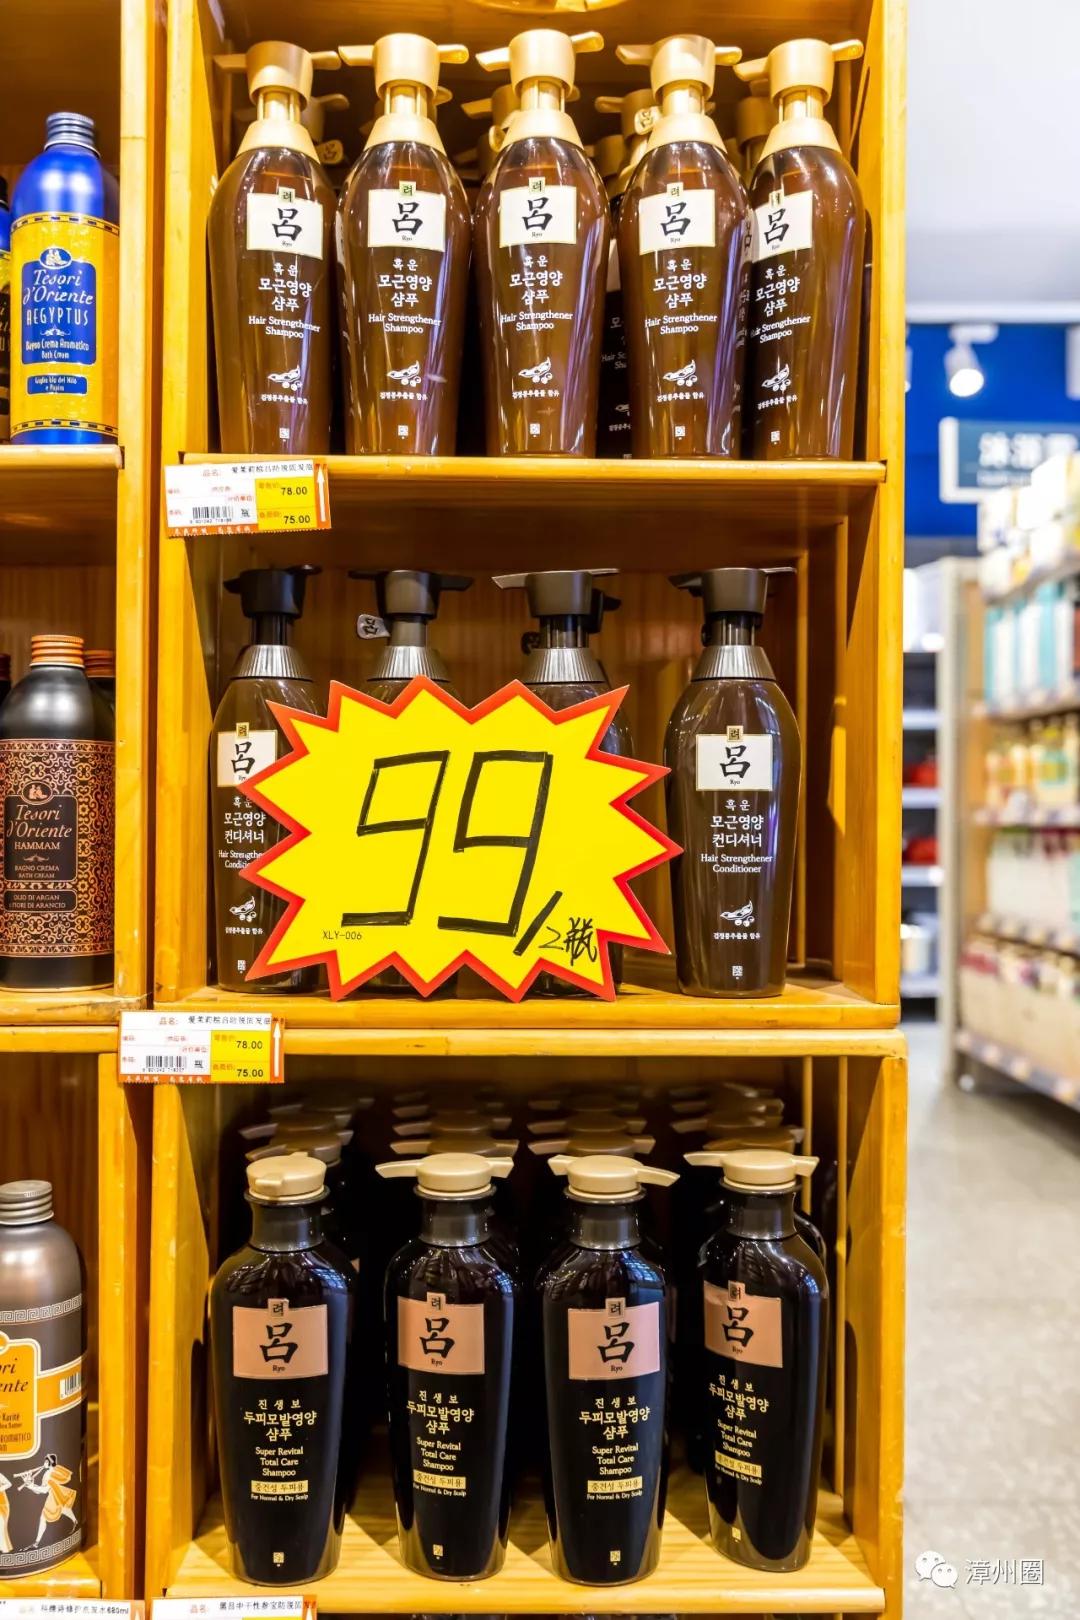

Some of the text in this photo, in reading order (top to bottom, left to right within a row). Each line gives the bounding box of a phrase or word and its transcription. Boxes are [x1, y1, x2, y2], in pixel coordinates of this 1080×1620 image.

[392, 202, 423, 235] 呂
[522, 197, 553, 231] 呂
[660, 201, 691, 236] 呂
[272, 208, 302, 241] 呂
[764, 208, 790, 245] 呂
[33, 269, 82, 286] Tesori
[378, 274, 432, 291] 모근영양
[509, 270, 563, 287] 모근영양
[653, 273, 707, 292] 모근영양
[258, 278, 312, 297] 모근영양
[755, 276, 801, 302] 모근영양
[272, 296, 299, 312] 샴푸
[391, 292, 419, 307] 샴푸
[521, 289, 550, 306] 샴푸
[665, 293, 694, 310] 샴푸
[764, 298, 788, 317] 샴푸
[26, 307, 88, 326] AEGYPTUS
[248, 315, 320, 332] Hair Strengthener
[368, 312, 441, 326] Hair Strengthener
[500, 309, 573, 323] Hair Strengthener
[645, 312, 718, 328] Hair Strengthener
[265, 326, 304, 338] Shampoo
[384, 323, 424, 334] Shampoo
[516, 321, 554, 332] Shampoo
[660, 325, 699, 335] Shampoo
[762, 316, 811, 333] Strengthener
[760, 329, 792, 343] Shampoo
[281, 486, 308, 496] 78.00
[284, 515, 311, 524] 75.00
[231, 741, 255, 774] 呂
[719, 745, 751, 779] 呂
[16, 804, 62, 820] Tesori
[224, 812, 267, 827] 모근영양
[6, 820, 73, 838] d'Oriente
[710, 814, 764, 830] 모근영양
[225, 829, 264, 844] 컨디셔너
[712, 832, 762, 848] 컨디셔너
[14, 842, 60, 850] HAMMAM
[701, 853, 773, 864] Hair Strengthener
[712, 864, 762, 873] Conditioner
[323, 931, 362, 940] XLY-006
[236, 1040, 263, 1049] 78.00
[236, 1069, 264, 1077] 75.00
[722, 1305, 754, 1347] 呂
[260, 1323, 298, 1363] 呂
[419, 1317, 455, 1359] 呂
[597, 1322, 635, 1363] 呂
[244, 1410, 318, 1427] 두피모발영양
[406, 1400, 475, 1422] 두피모발영양
[579, 1406, 651, 1425] 두피모발영양
[266, 1428, 292, 1442] 샴푸
[425, 1420, 450, 1435] 샴푸
[602, 1425, 629, 1440] 샴푸
[255, 1446, 304, 1456] Super Revital
[416, 1437, 461, 1451] Super Revital
[592, 1442, 639, 1456] Super Revital
[260, 1457, 299, 1466] Total Care
[420, 1448, 457, 1461] Total Care
[596, 1455, 635, 1465] Total Care
[262, 1468, 296, 1478] Shampoo
[423, 1459, 454, 1472] Shampoo
[599, 1466, 632, 1476] Shampoo
